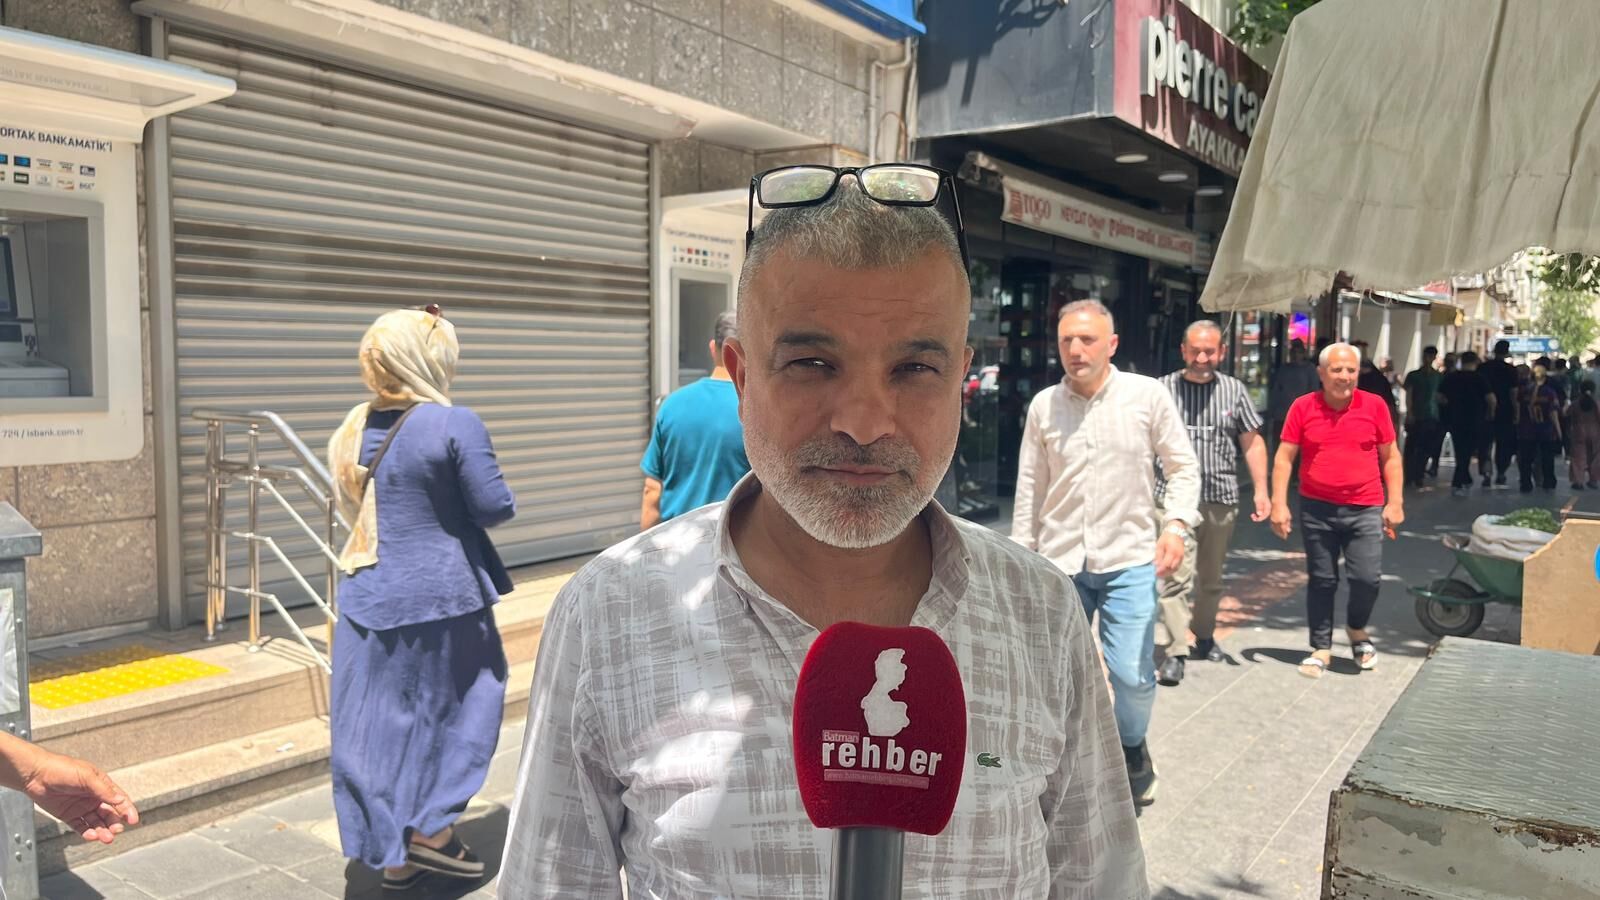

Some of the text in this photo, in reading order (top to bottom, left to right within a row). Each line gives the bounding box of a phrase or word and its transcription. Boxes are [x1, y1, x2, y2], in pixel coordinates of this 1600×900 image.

[1140, 15, 1265, 138] pierre ca
[0, 126, 36, 141] ORTAK
[823, 730, 859, 742] Batman
[822, 736, 942, 776] rehber
